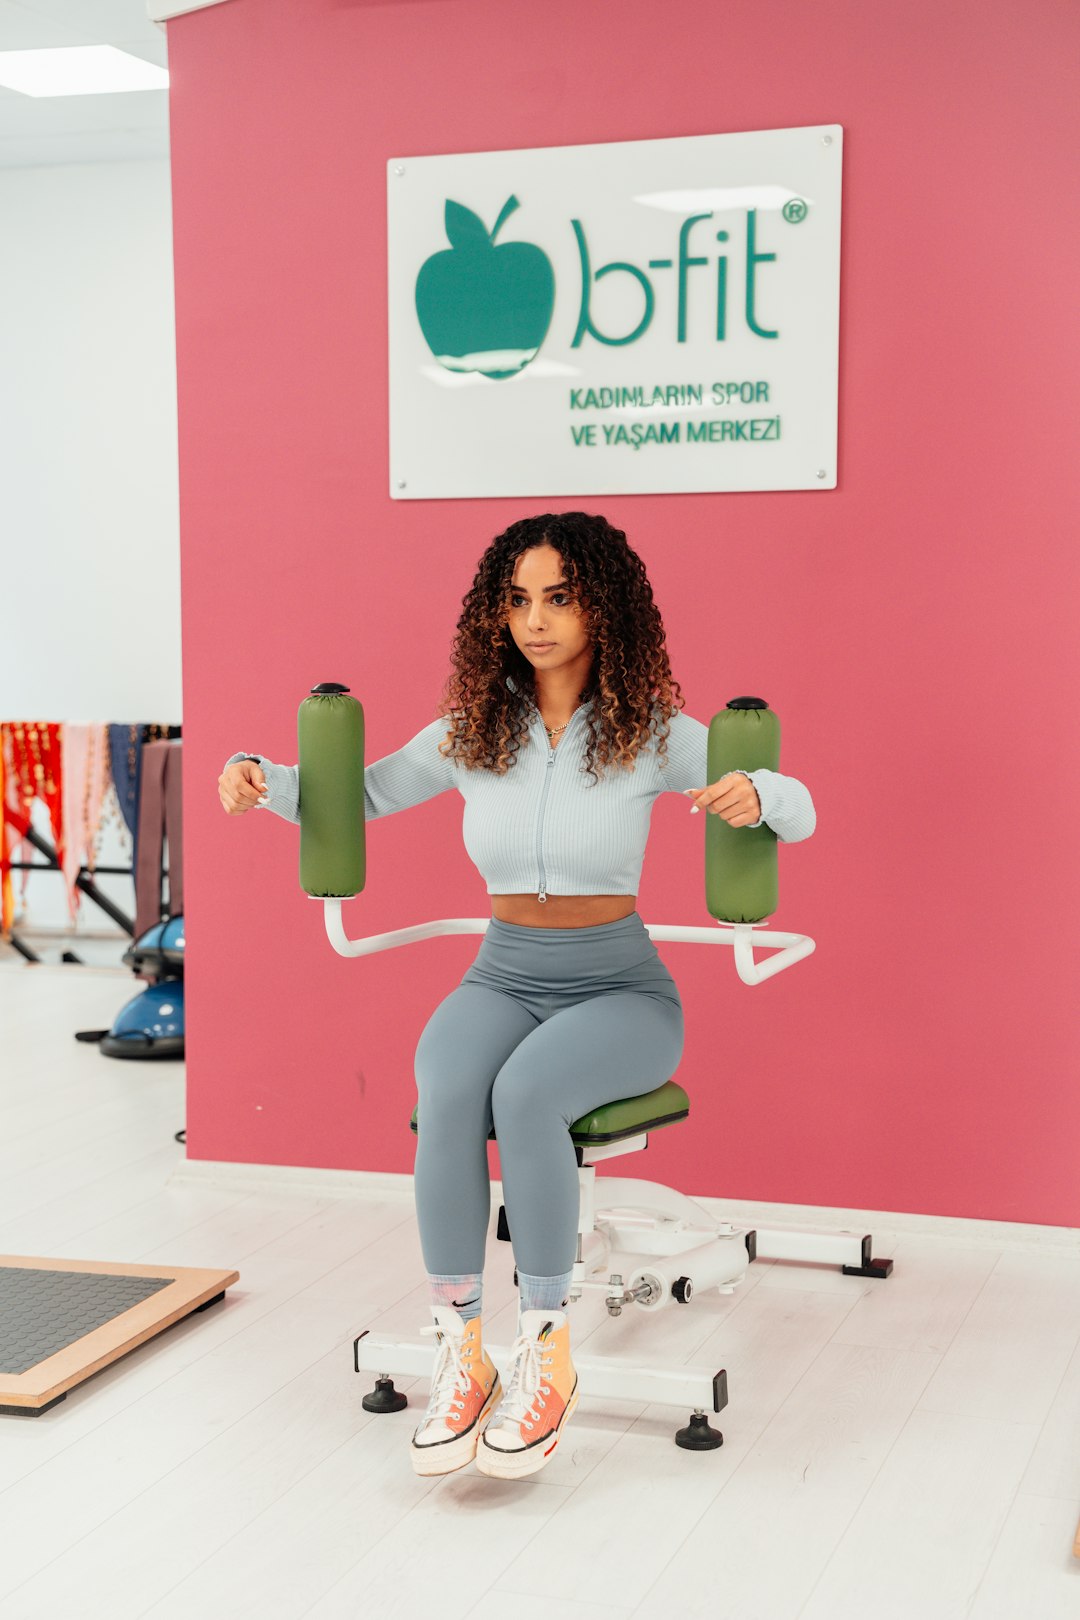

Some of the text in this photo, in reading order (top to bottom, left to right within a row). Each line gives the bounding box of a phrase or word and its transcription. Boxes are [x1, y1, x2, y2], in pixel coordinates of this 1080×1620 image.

[570, 208, 779, 349] b-fit
[570, 380, 771, 410] KADINLARIN SPOR
[571, 415, 783, 452] VE YAŞAM MERKEZİ
